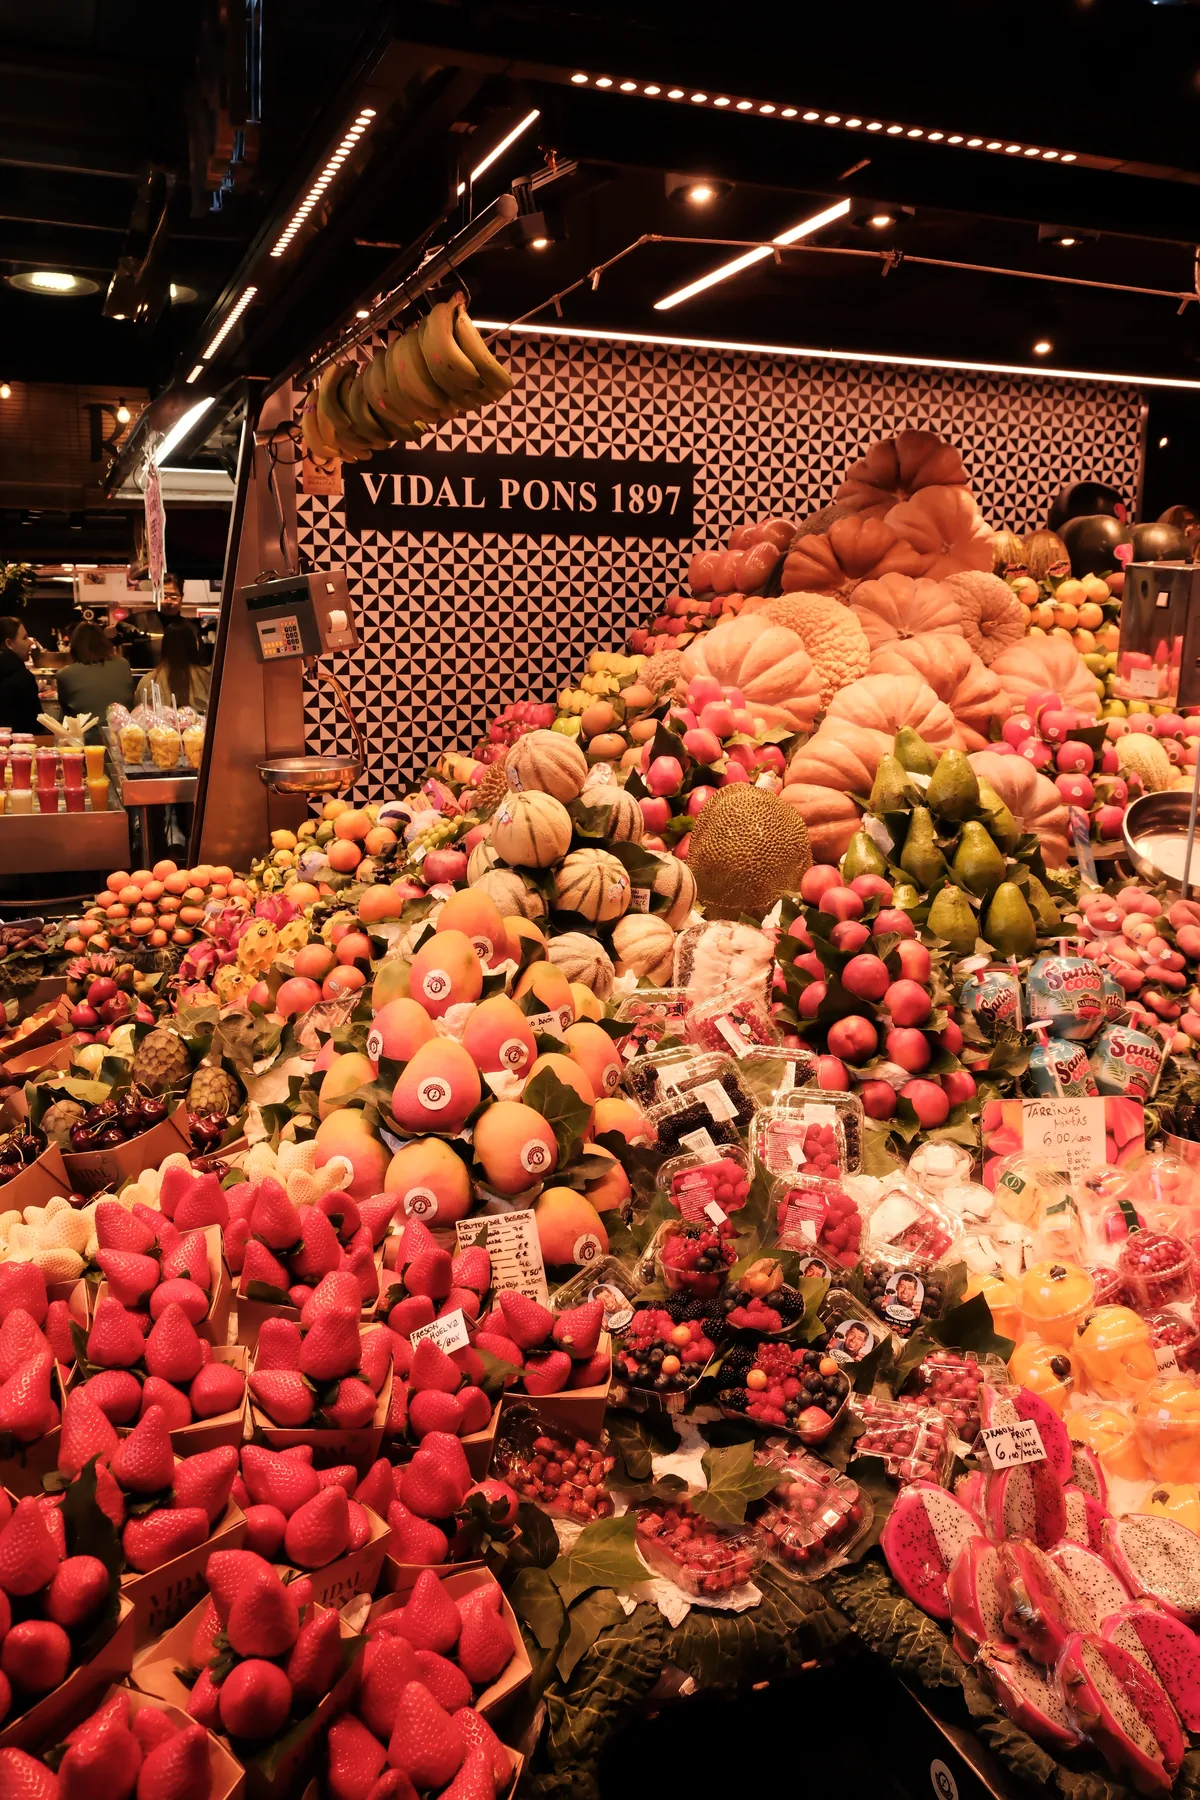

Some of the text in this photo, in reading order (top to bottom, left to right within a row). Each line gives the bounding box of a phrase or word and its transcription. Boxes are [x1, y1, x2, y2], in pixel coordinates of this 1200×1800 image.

[360, 472, 681, 515] VIDAL PONS 1897
[1045, 962, 1101, 991] Santa
[1064, 977, 1101, 992] coco
